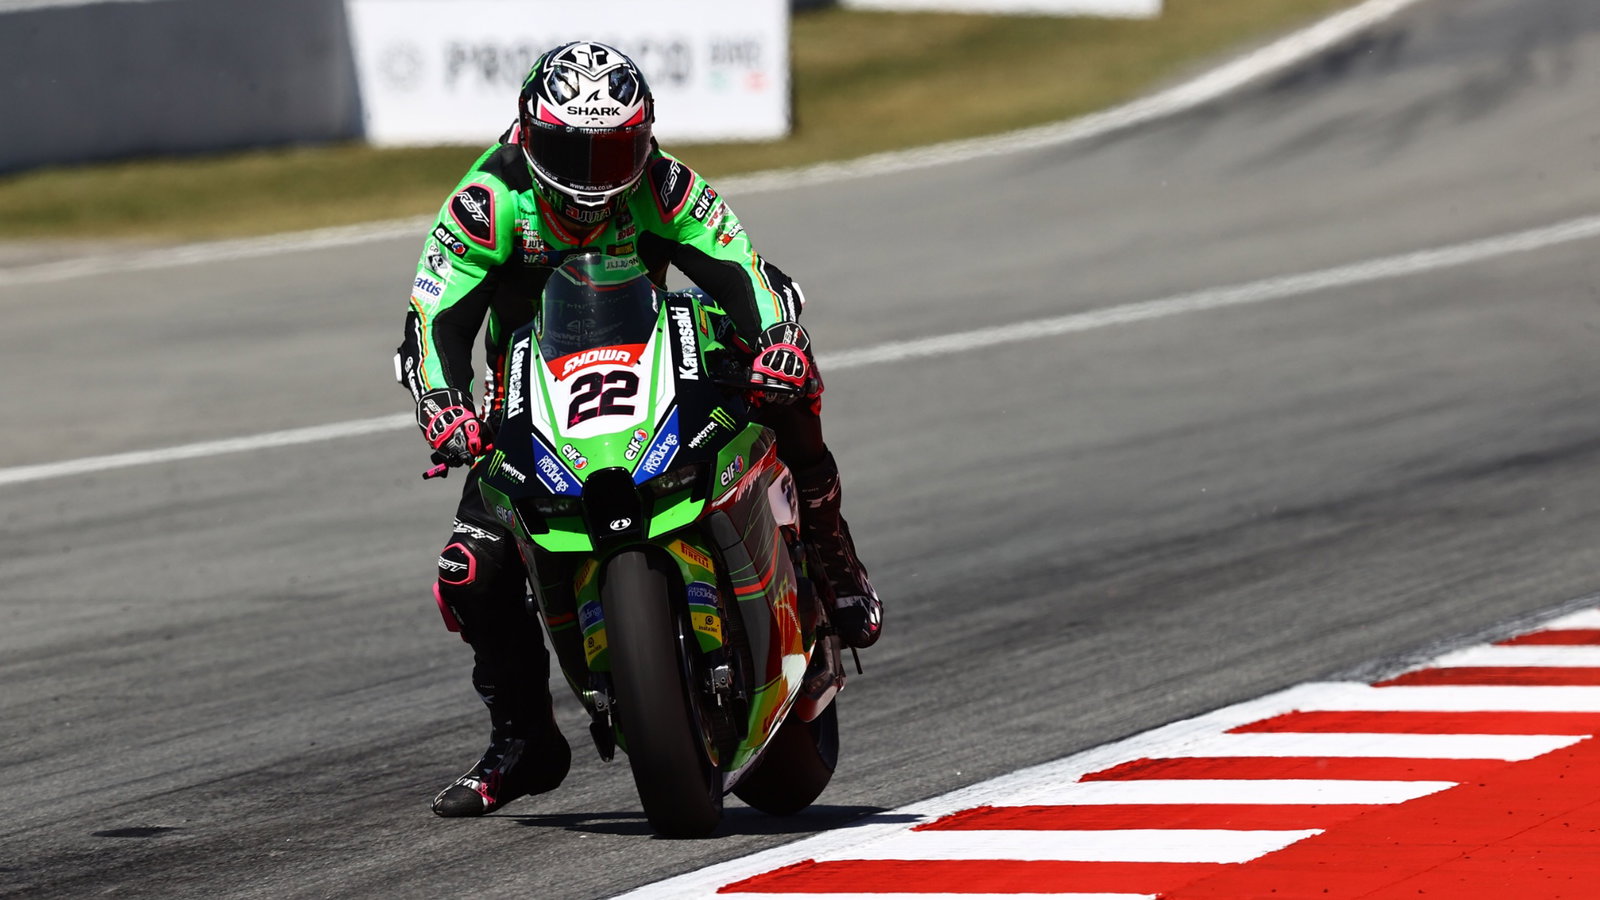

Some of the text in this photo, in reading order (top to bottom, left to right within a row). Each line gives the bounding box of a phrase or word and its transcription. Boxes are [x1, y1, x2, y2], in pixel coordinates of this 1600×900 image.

[567, 106, 621, 116] SHARK
[580, 127, 618, 135] TITANTECH
[569, 182, 614, 191] WWW.JUTA.CO.UK
[456, 191, 491, 228] RST
[694, 197, 710, 219] elf
[434, 227, 456, 246] elf
[670, 306, 699, 381] Kawasaki
[562, 349, 631, 377] SHOWA
[508, 337, 529, 419] Kawasaki
[567, 370, 640, 430] 22
[561, 444, 581, 462] elf
[624, 437, 642, 461] elf
[720, 462, 738, 487] elf
[680, 540, 709, 568] PIRELLI
